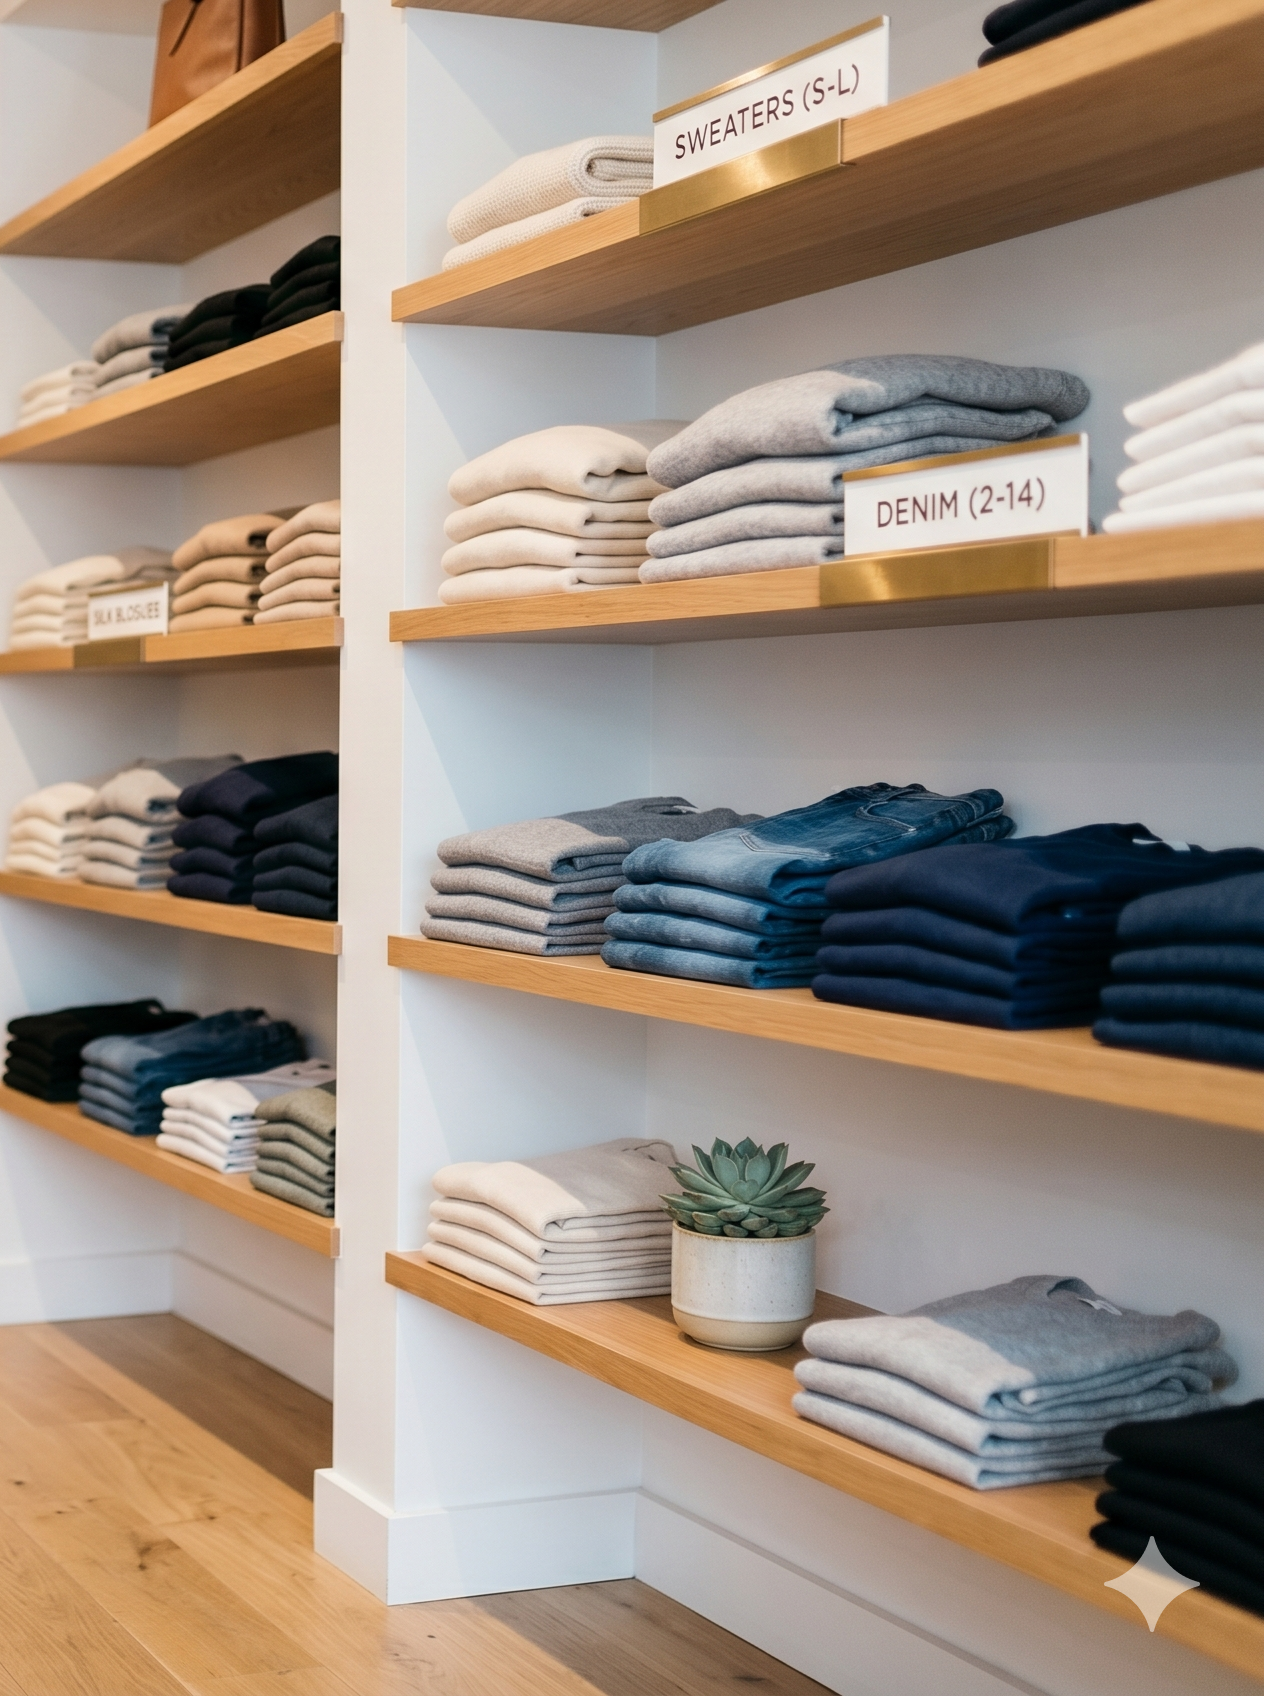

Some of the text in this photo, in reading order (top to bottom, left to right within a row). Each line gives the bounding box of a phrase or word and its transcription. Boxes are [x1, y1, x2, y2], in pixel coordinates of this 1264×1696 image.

[675, 63, 860, 160] SWEATERS (S-L)
[877, 477, 1046, 528] DENIM (2-14)
